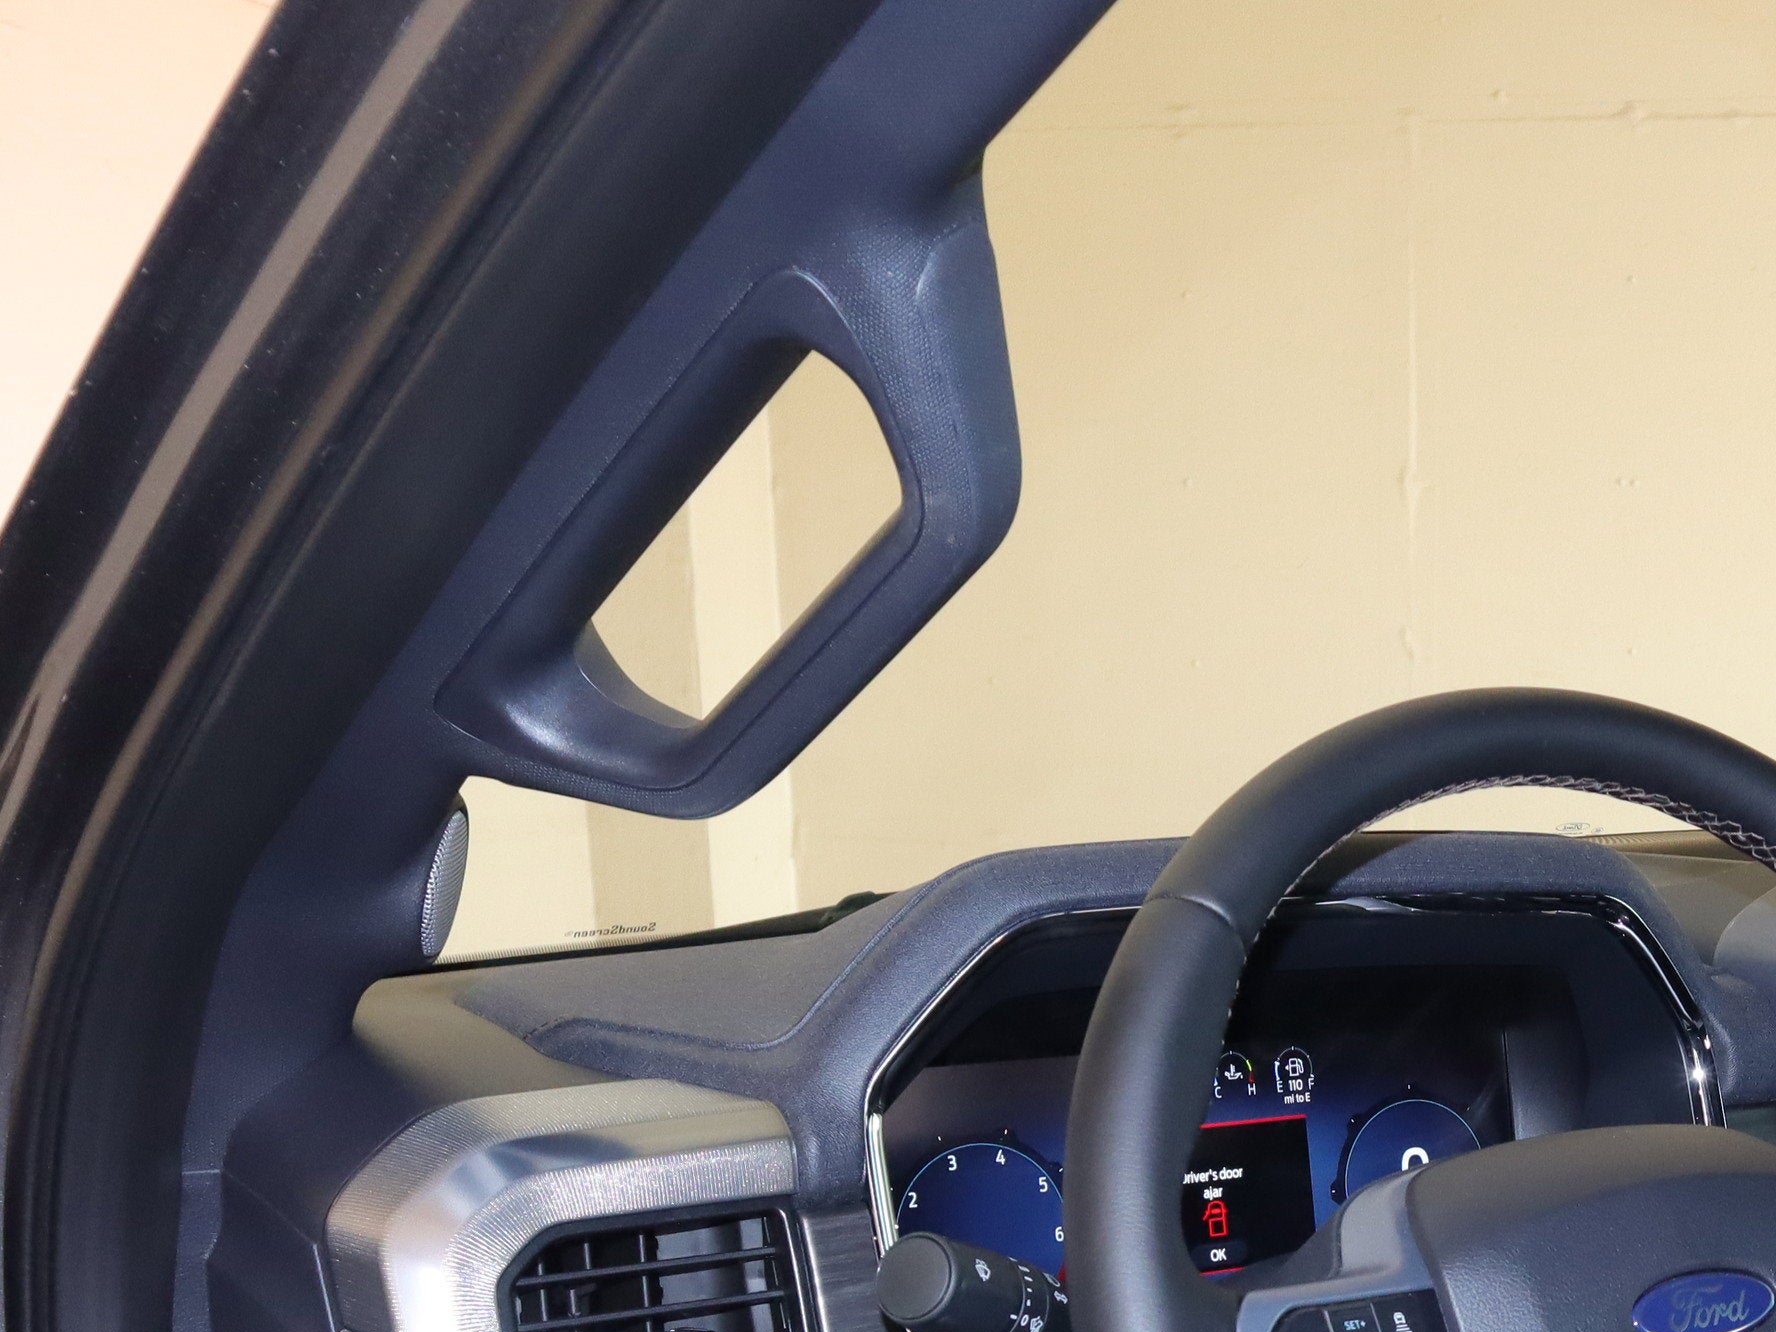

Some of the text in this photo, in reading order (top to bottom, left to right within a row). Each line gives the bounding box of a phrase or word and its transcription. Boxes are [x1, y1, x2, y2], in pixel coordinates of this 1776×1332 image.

[1214, 1083, 1256, 1099] C H
[1276, 1078, 1315, 1093] E 110 F
[1284, 1092, 1311, 1105] mi to E
[947, 1155, 958, 1171] 3
[995, 1149, 1006, 1166] 4
[1219, 1166, 1244, 1181] door
[1038, 1176, 1048, 1193] 5
[907, 1191, 918, 1208] 2
[1203, 1186, 1224, 1200] ajar
[1054, 1226, 1065, 1242] 6
[1210, 1248, 1228, 1262] OK
[1669, 1284, 1750, 1332] Ford
[1020, 1313, 1029, 1327] 0
[1344, 1319, 1367, 1331] SET+
